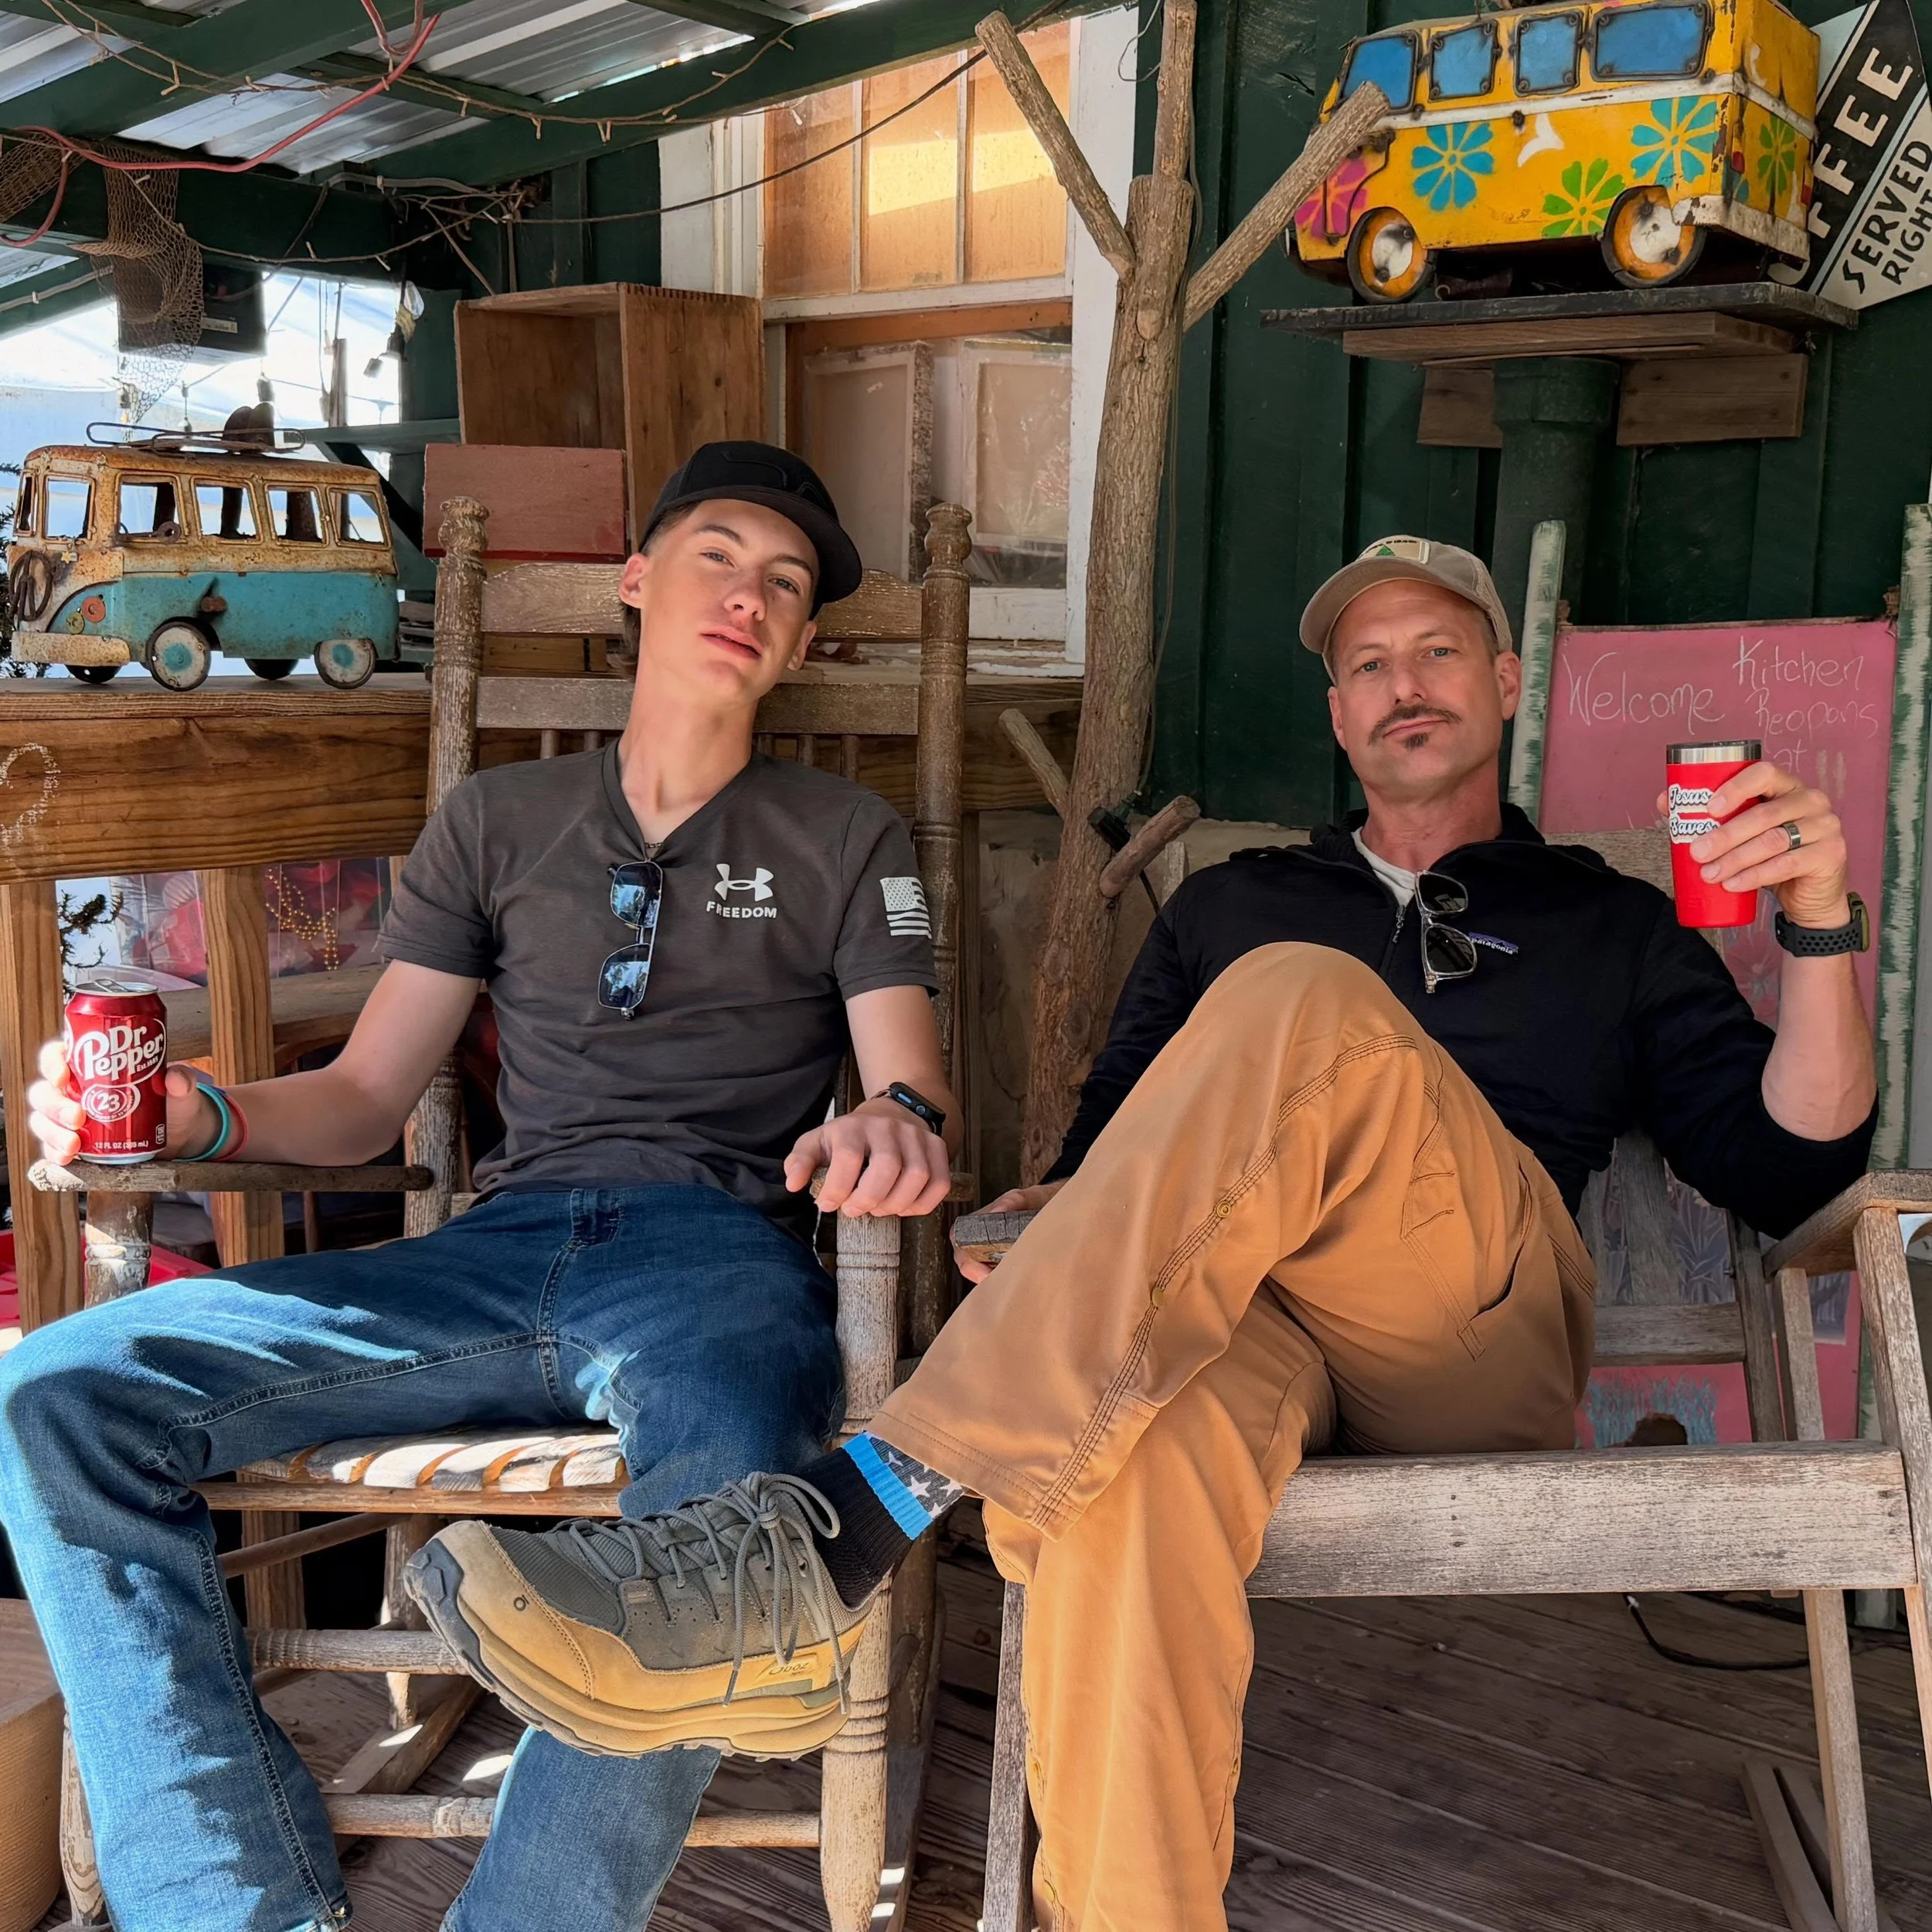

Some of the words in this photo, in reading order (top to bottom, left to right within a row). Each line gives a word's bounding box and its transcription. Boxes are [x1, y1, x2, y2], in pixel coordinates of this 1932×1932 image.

[1842, 141, 1932, 294] SERVED
[1733, 635, 1864, 690] Kitchen
[1562, 651, 1725, 735] Welcome
[1669, 787, 1712, 810] Jesus
[1669, 817, 1718, 837] Saves
[706, 900, 777, 919] FREEDOM
[1471, 937, 1514, 955] patagonia
[108, 1025, 147, 1055] Dr
[74, 1030, 164, 1081] Pepper
[97, 1092, 121, 1113] 23
